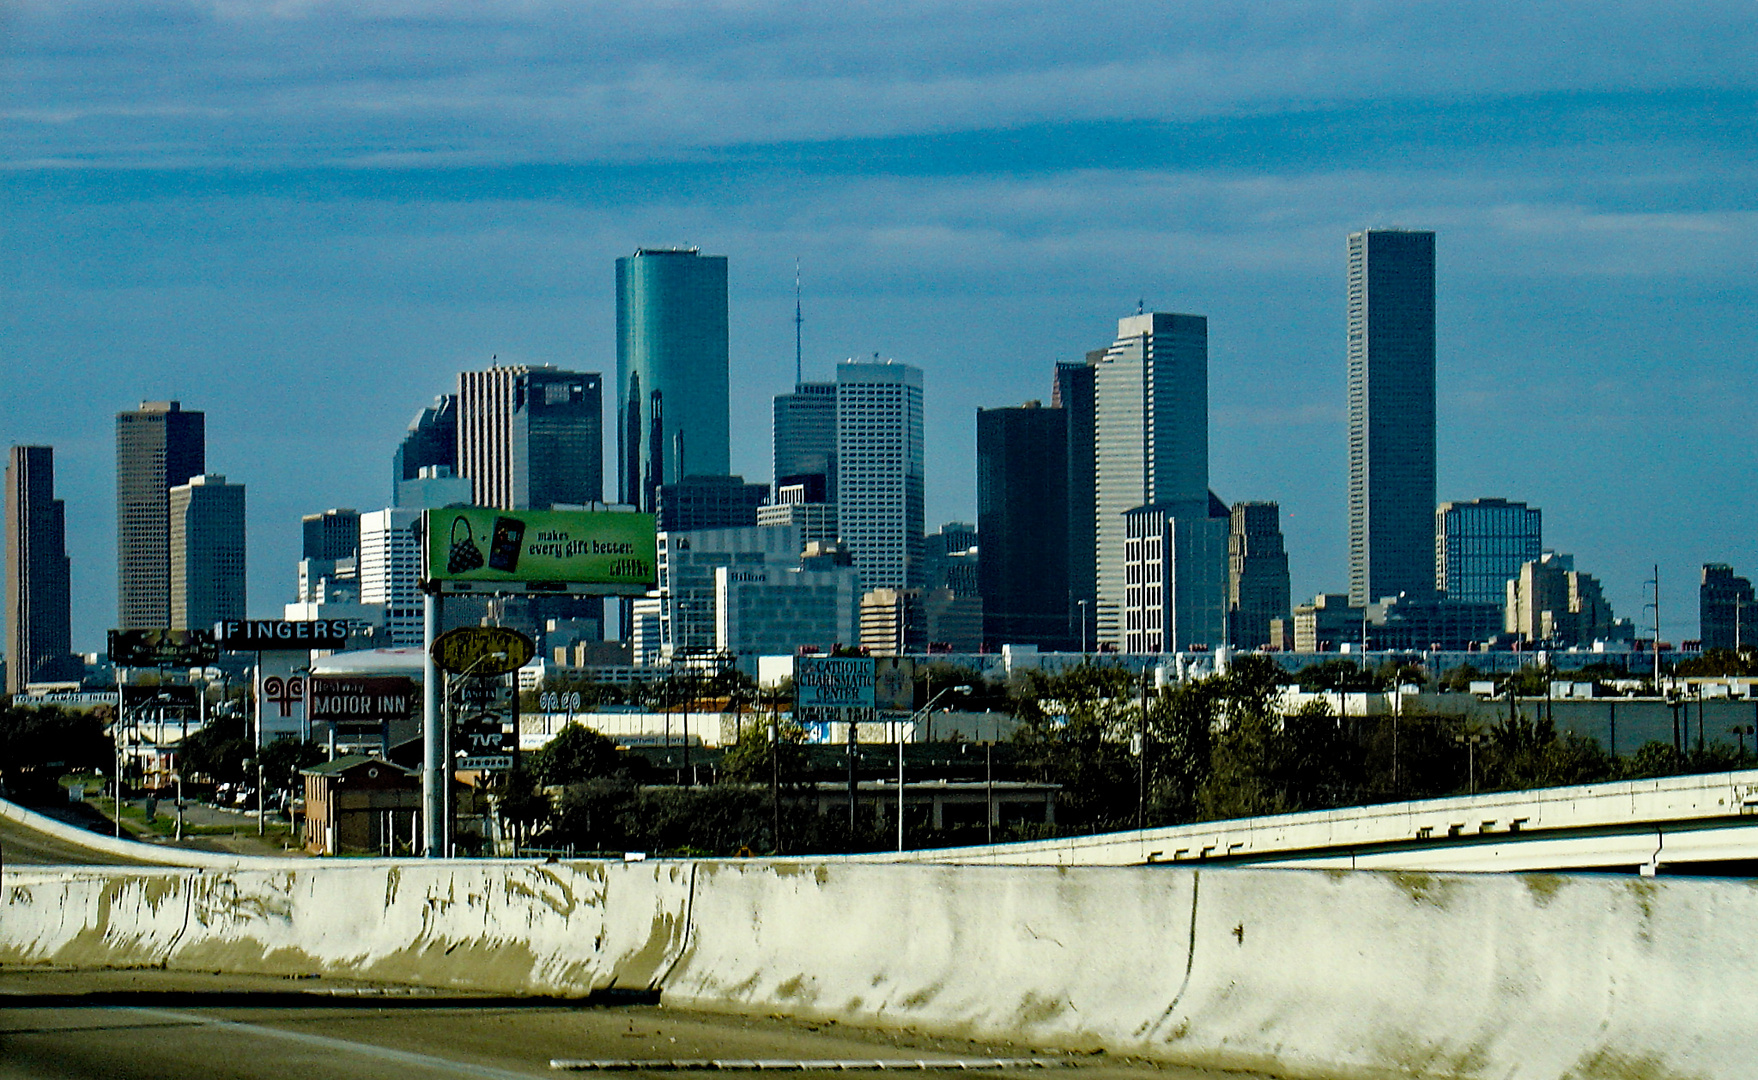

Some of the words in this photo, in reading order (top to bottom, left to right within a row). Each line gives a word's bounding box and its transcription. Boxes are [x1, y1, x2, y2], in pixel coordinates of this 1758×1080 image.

[537, 530, 569, 541] makes
[529, 543, 562, 558] every
[565, 540, 588, 558] gift
[731, 572, 766, 582] Hilton
[227, 621, 347, 639] FINGERS
[816, 661, 871, 674] CATHOLIC
[800, 674, 872, 687] CHARISMATIC
[816, 687, 860, 699] CENTER
[314, 695, 372, 714] MOTOR
[377, 695, 406, 714] INN
